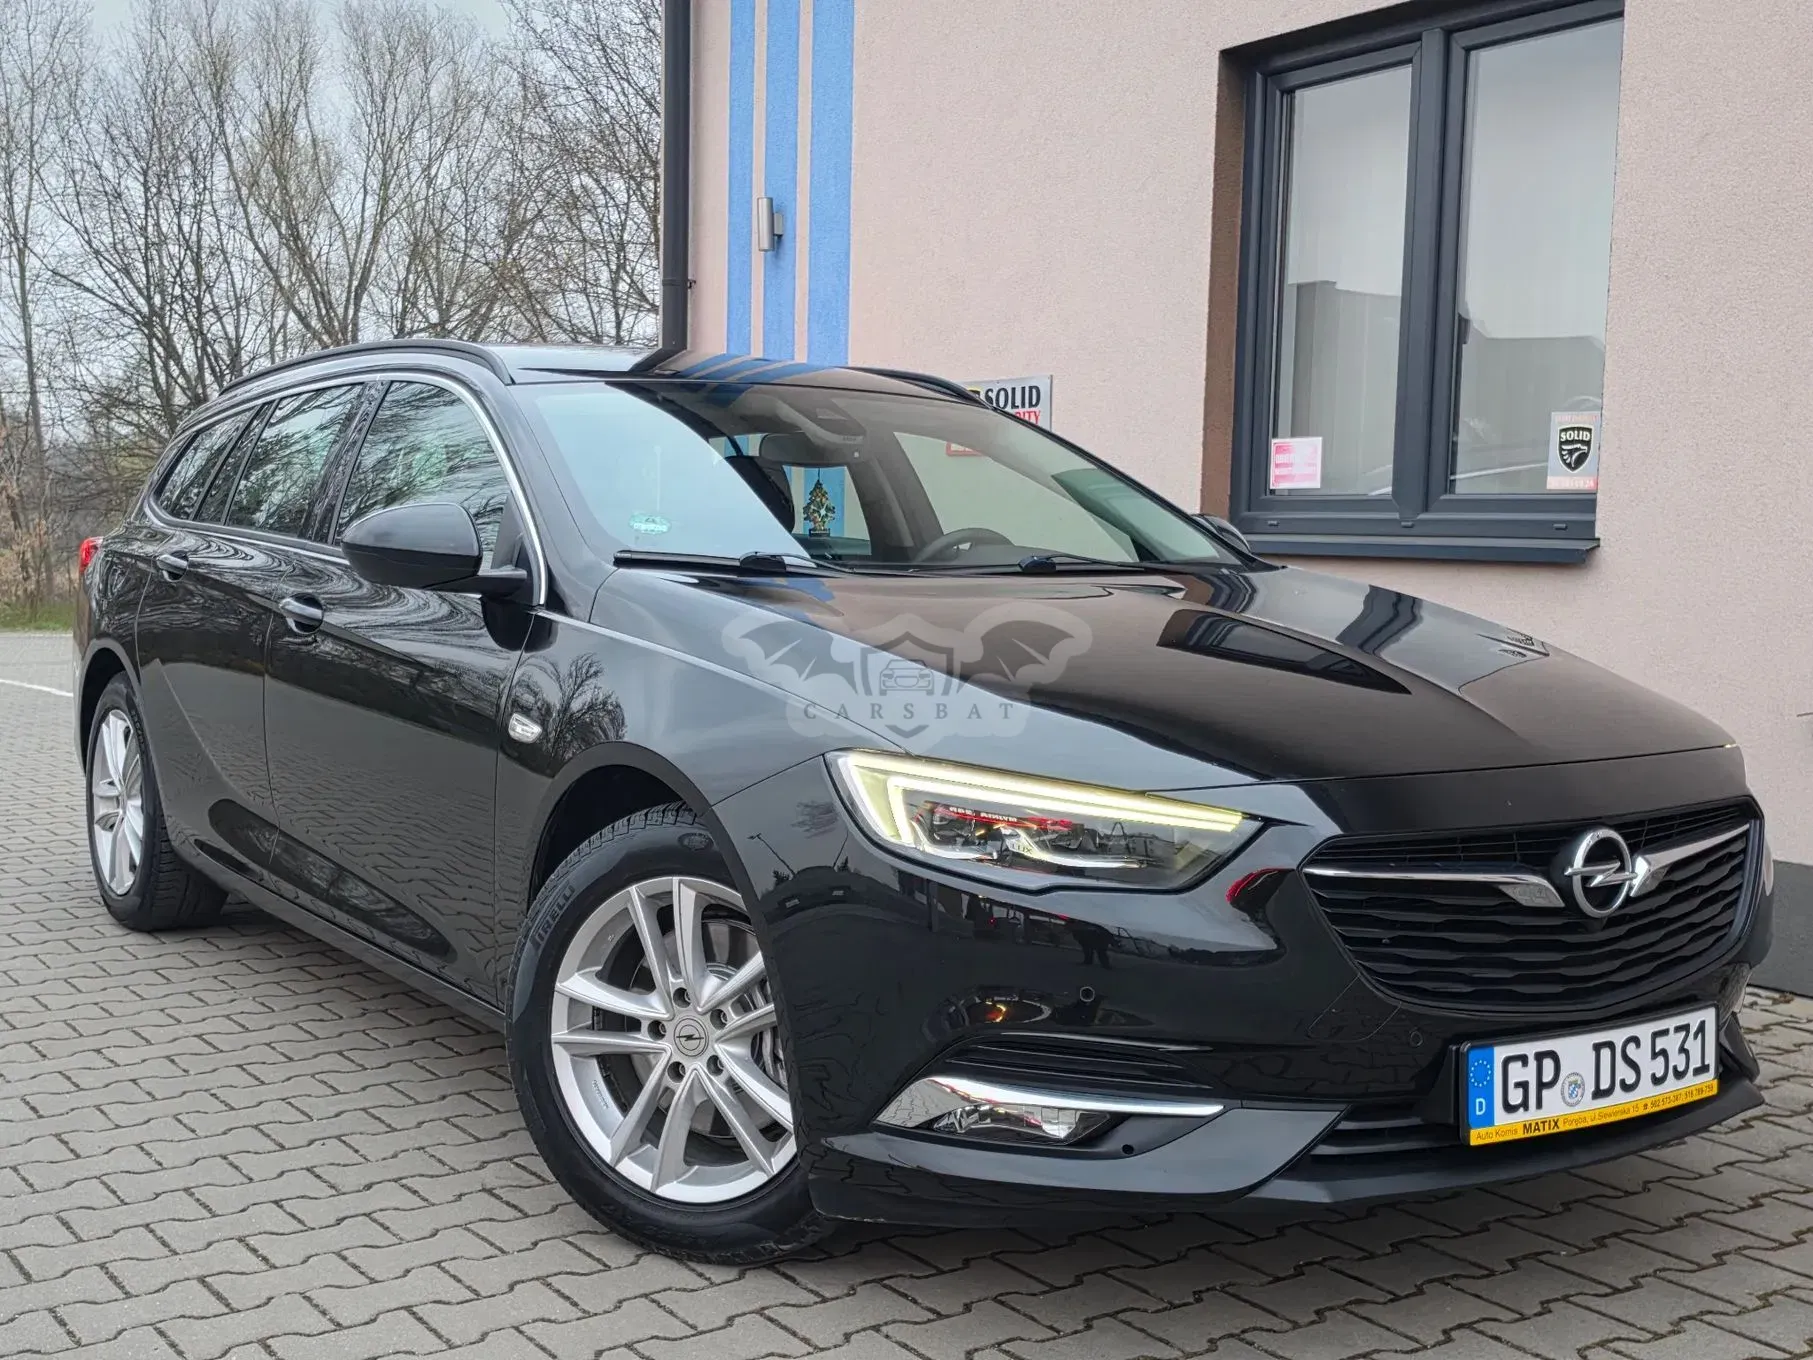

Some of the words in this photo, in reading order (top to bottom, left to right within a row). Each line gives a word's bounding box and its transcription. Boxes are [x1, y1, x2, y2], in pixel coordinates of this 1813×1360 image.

[984, 385, 1041, 411] SOLID
[1560, 430, 1590, 441] SOLID
[1501, 1049, 1561, 1114] GP
[1591, 1035, 1642, 1101] DS
[1650, 1019, 1711, 1087] 531
[1475, 1097, 1486, 1116] D
[1476, 1131, 1494, 1141] Auto
[1495, 1128, 1518, 1138] Komis
[1522, 1118, 1560, 1136] MATIX
